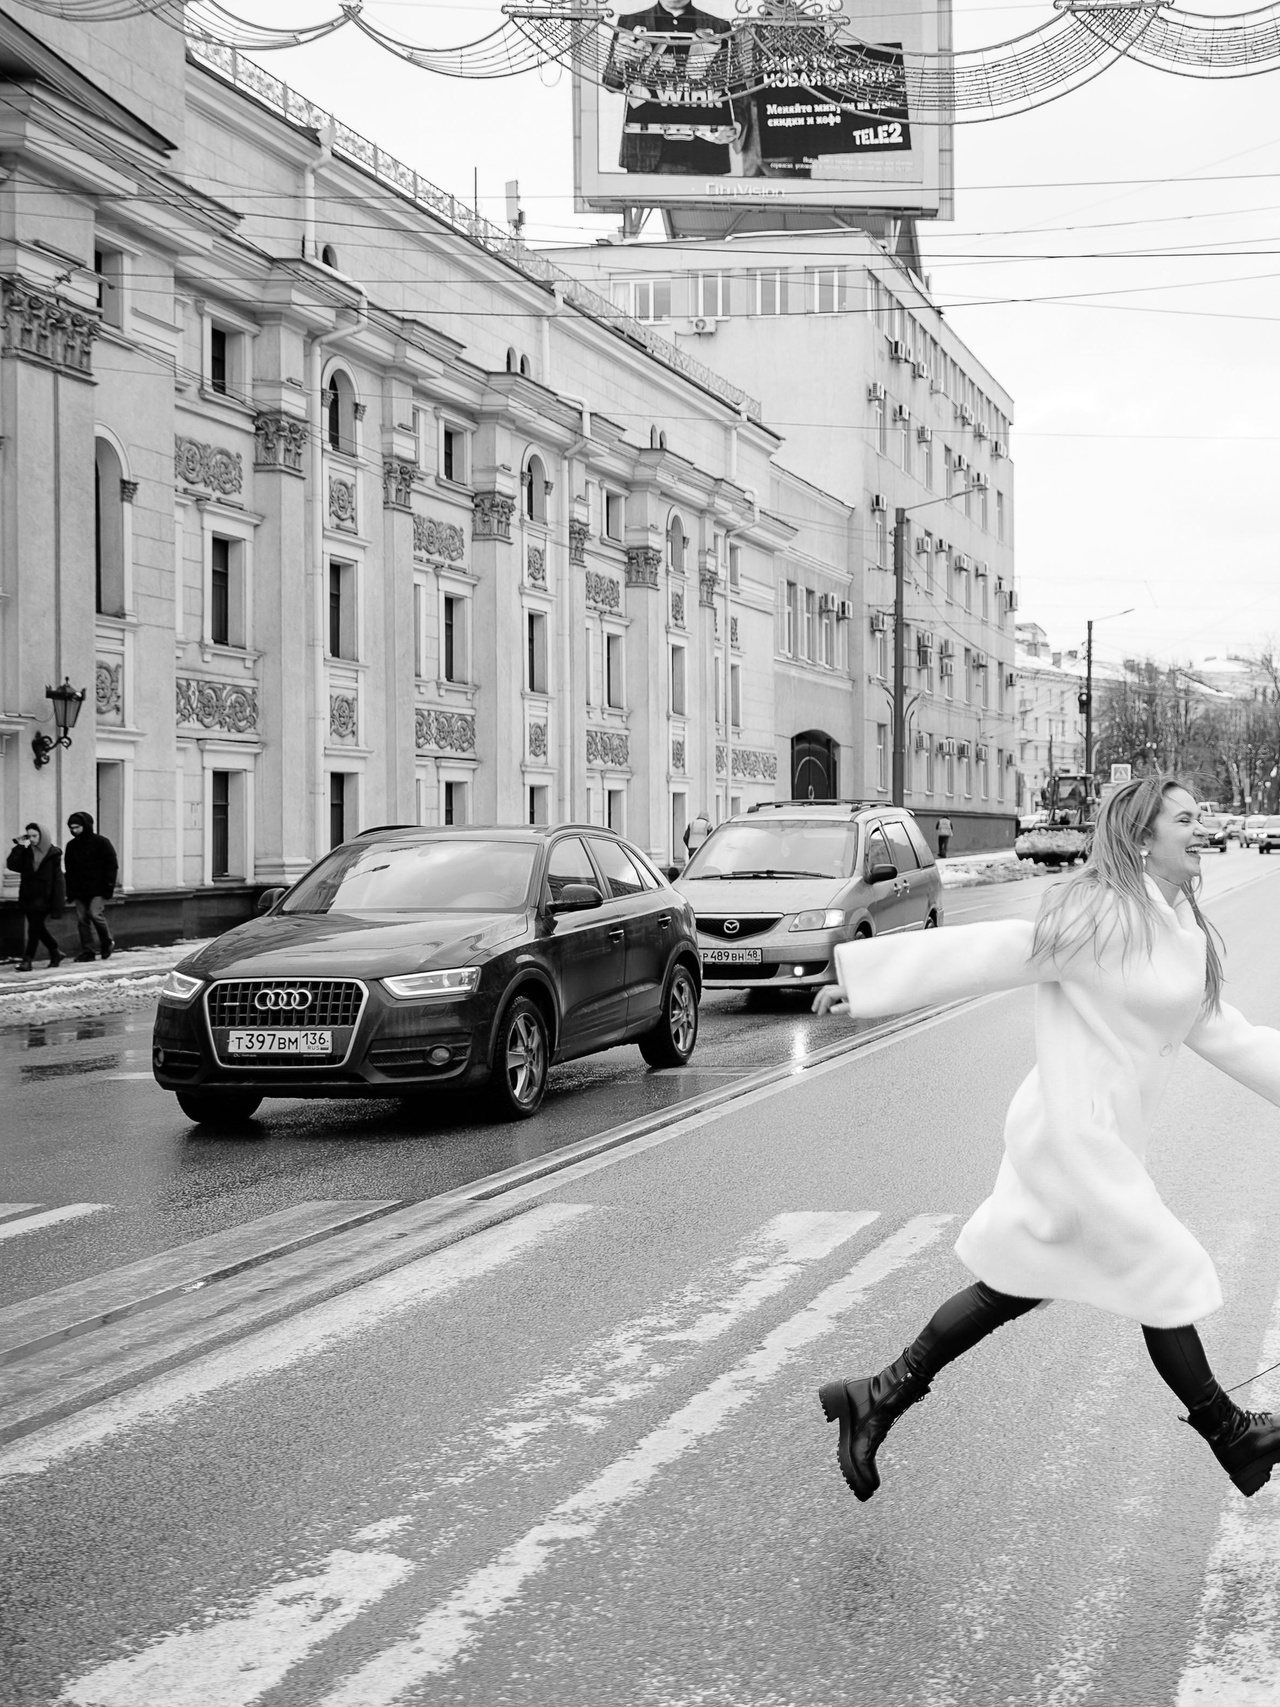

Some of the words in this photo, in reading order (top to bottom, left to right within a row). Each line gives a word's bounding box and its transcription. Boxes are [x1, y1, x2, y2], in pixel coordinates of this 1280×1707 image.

[766, 103, 813, 115] Меняйте
[767, 116, 805, 127] скидки
[806, 115, 815, 125] и
[815, 113, 842, 127] кофе
[853, 122, 904, 145] TELE2
[705, 182, 786, 199] CityVision
[747, 950, 758, 959] 48
[234, 1033, 299, 1050] Т397ВМ
[302, 1032, 326, 1045] 136
